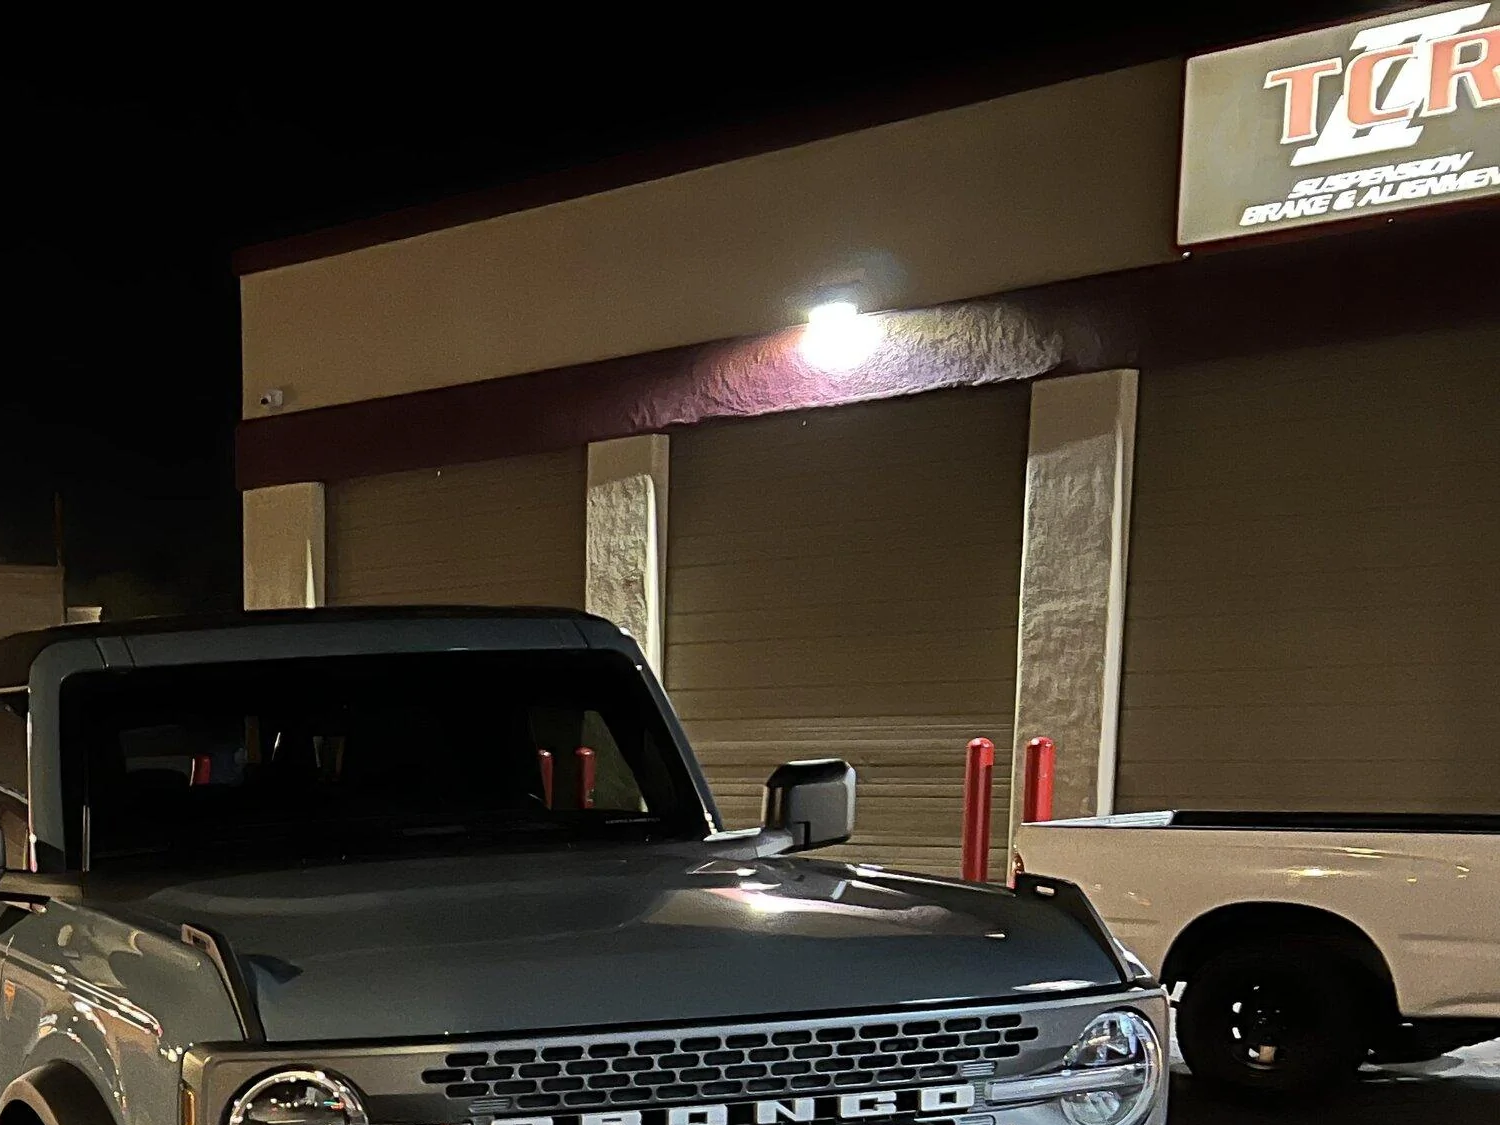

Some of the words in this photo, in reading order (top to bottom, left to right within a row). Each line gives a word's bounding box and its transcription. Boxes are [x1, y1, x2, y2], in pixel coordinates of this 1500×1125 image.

[1263, 25, 1500, 145] TCR
[1287, 151, 1474, 199] SUSPENSION
[1239, 194, 1330, 226] BRAKE
[1332, 190, 1357, 211] &
